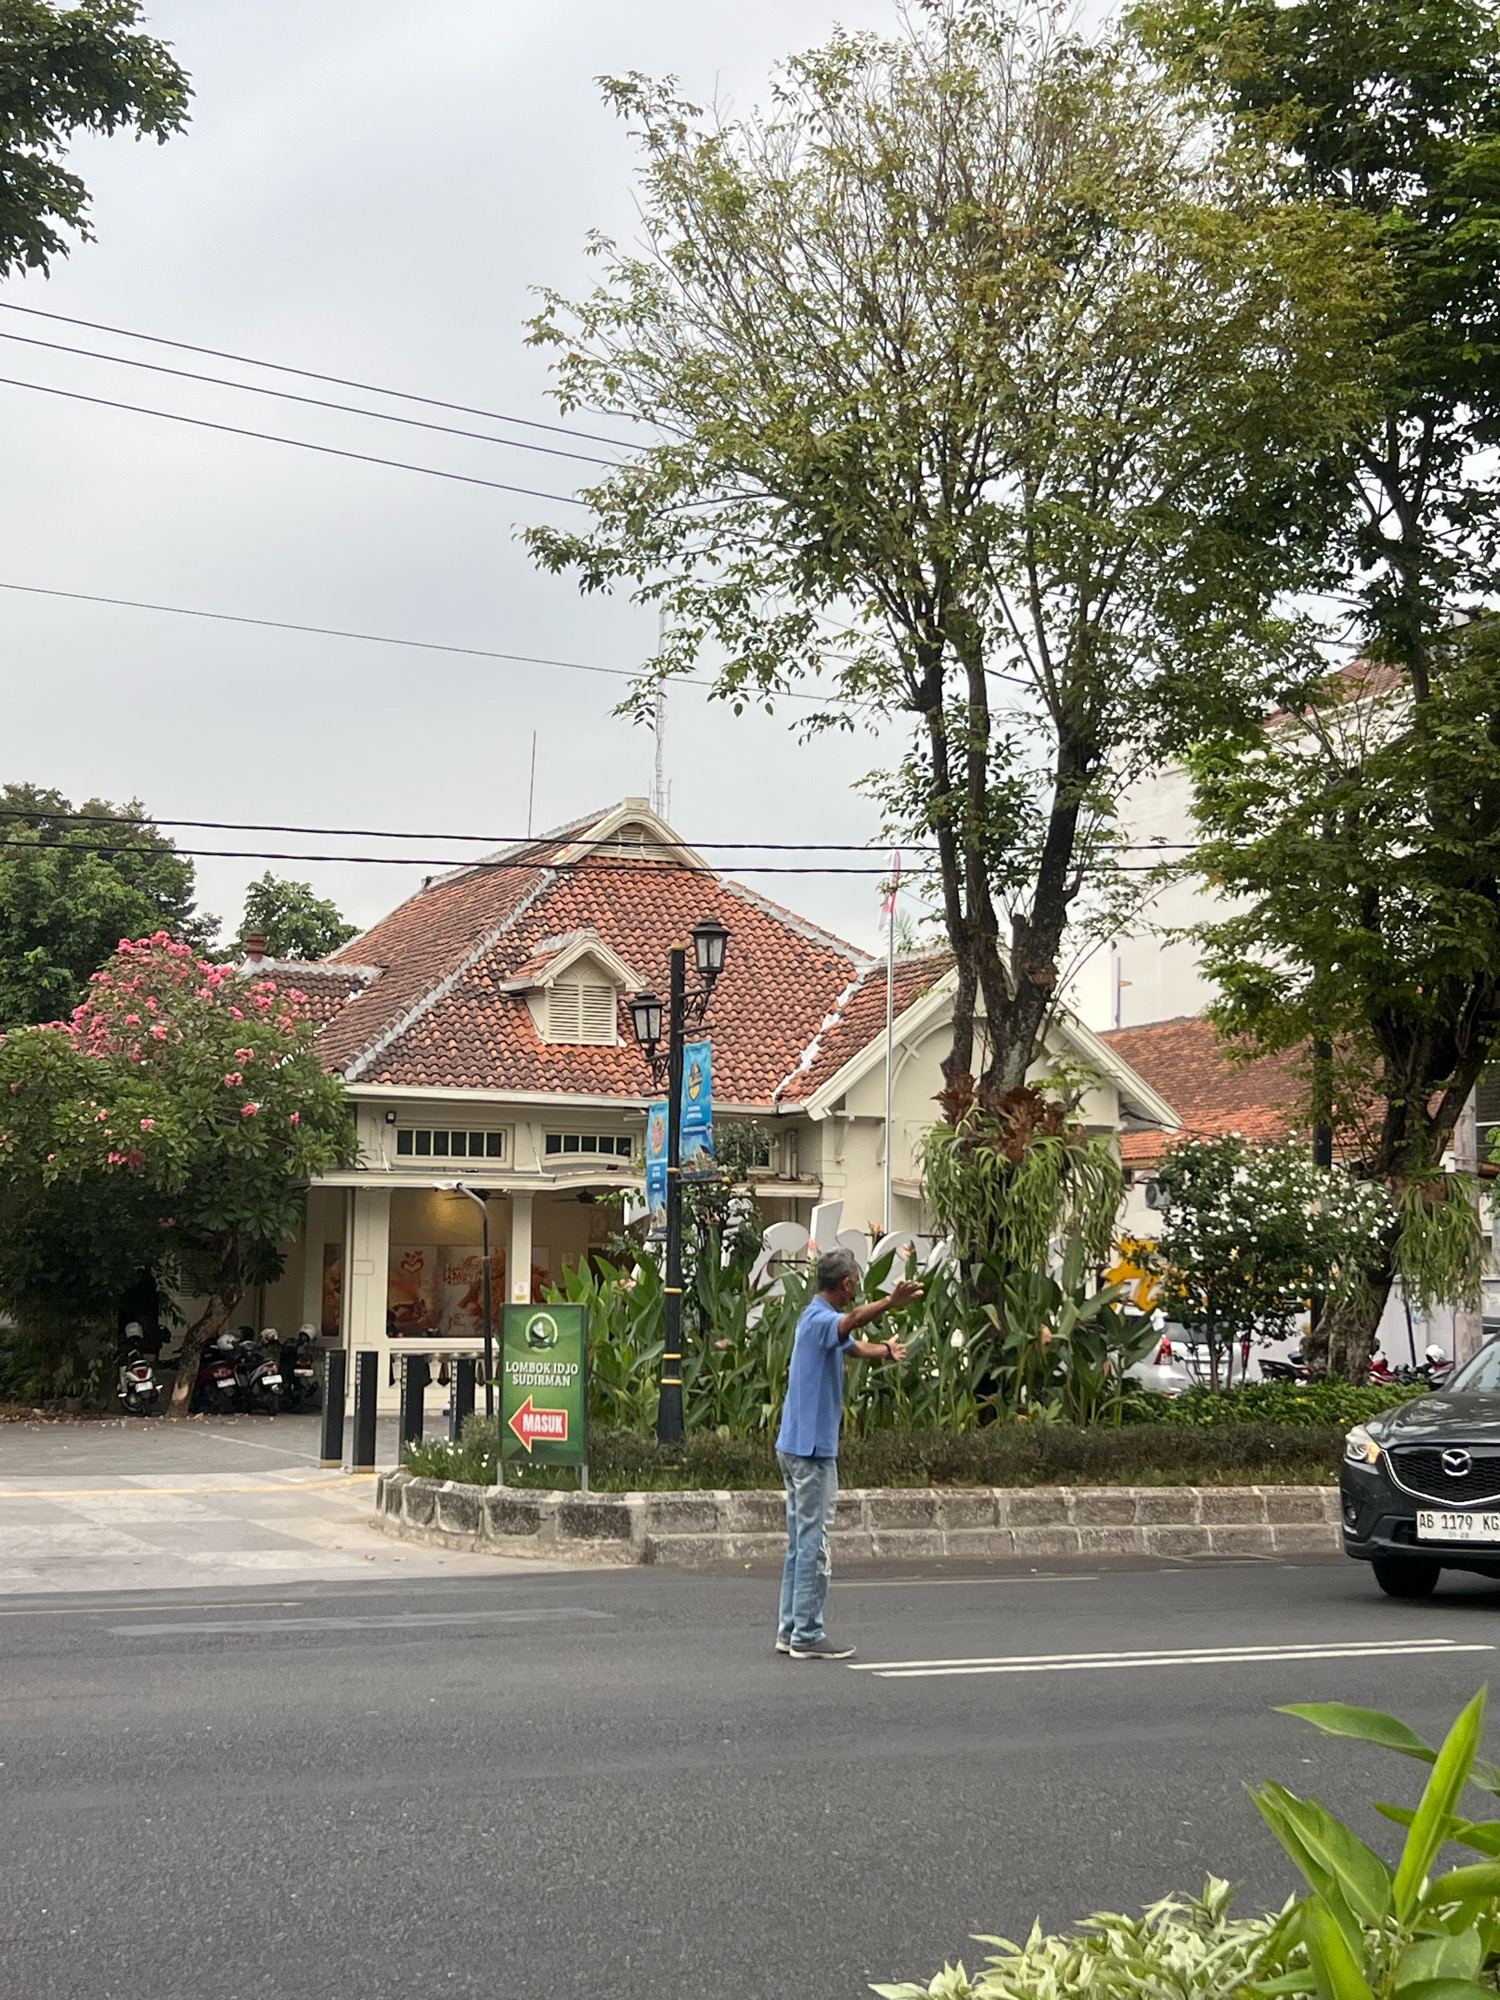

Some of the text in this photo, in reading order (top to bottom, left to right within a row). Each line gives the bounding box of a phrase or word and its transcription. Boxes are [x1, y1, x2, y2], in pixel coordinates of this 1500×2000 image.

[505, 1361, 579, 1375] LOMBOK IDJO
[512, 1373, 571, 1387] SUDIRMAN
[522, 1413, 563, 1434] MASUK
[1419, 1514, 1499, 1531] AB 1179 KG
